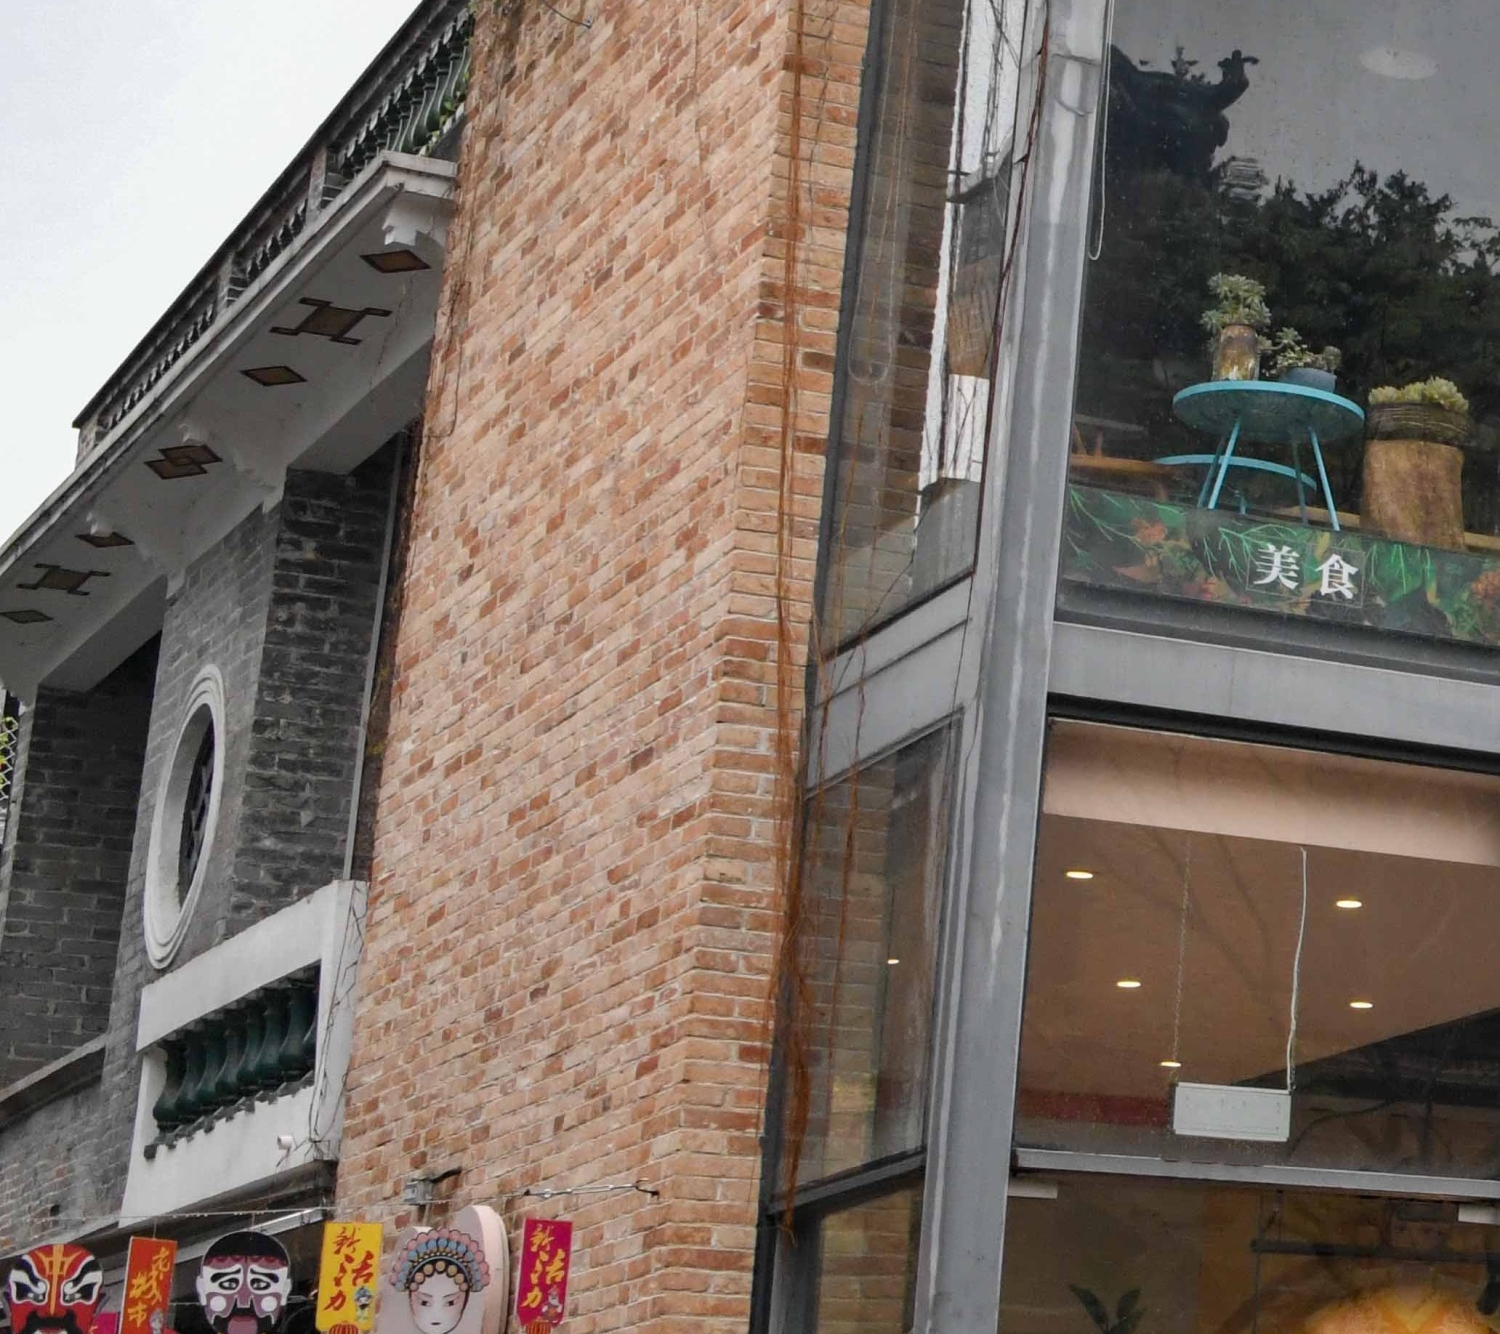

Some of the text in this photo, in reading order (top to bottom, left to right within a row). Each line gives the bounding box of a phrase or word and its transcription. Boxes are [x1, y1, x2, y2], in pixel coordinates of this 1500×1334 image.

[1253, 541, 1359, 599] 美食
[323, 1225, 374, 1312] 新活力
[521, 1223, 565, 1309] 新活力
